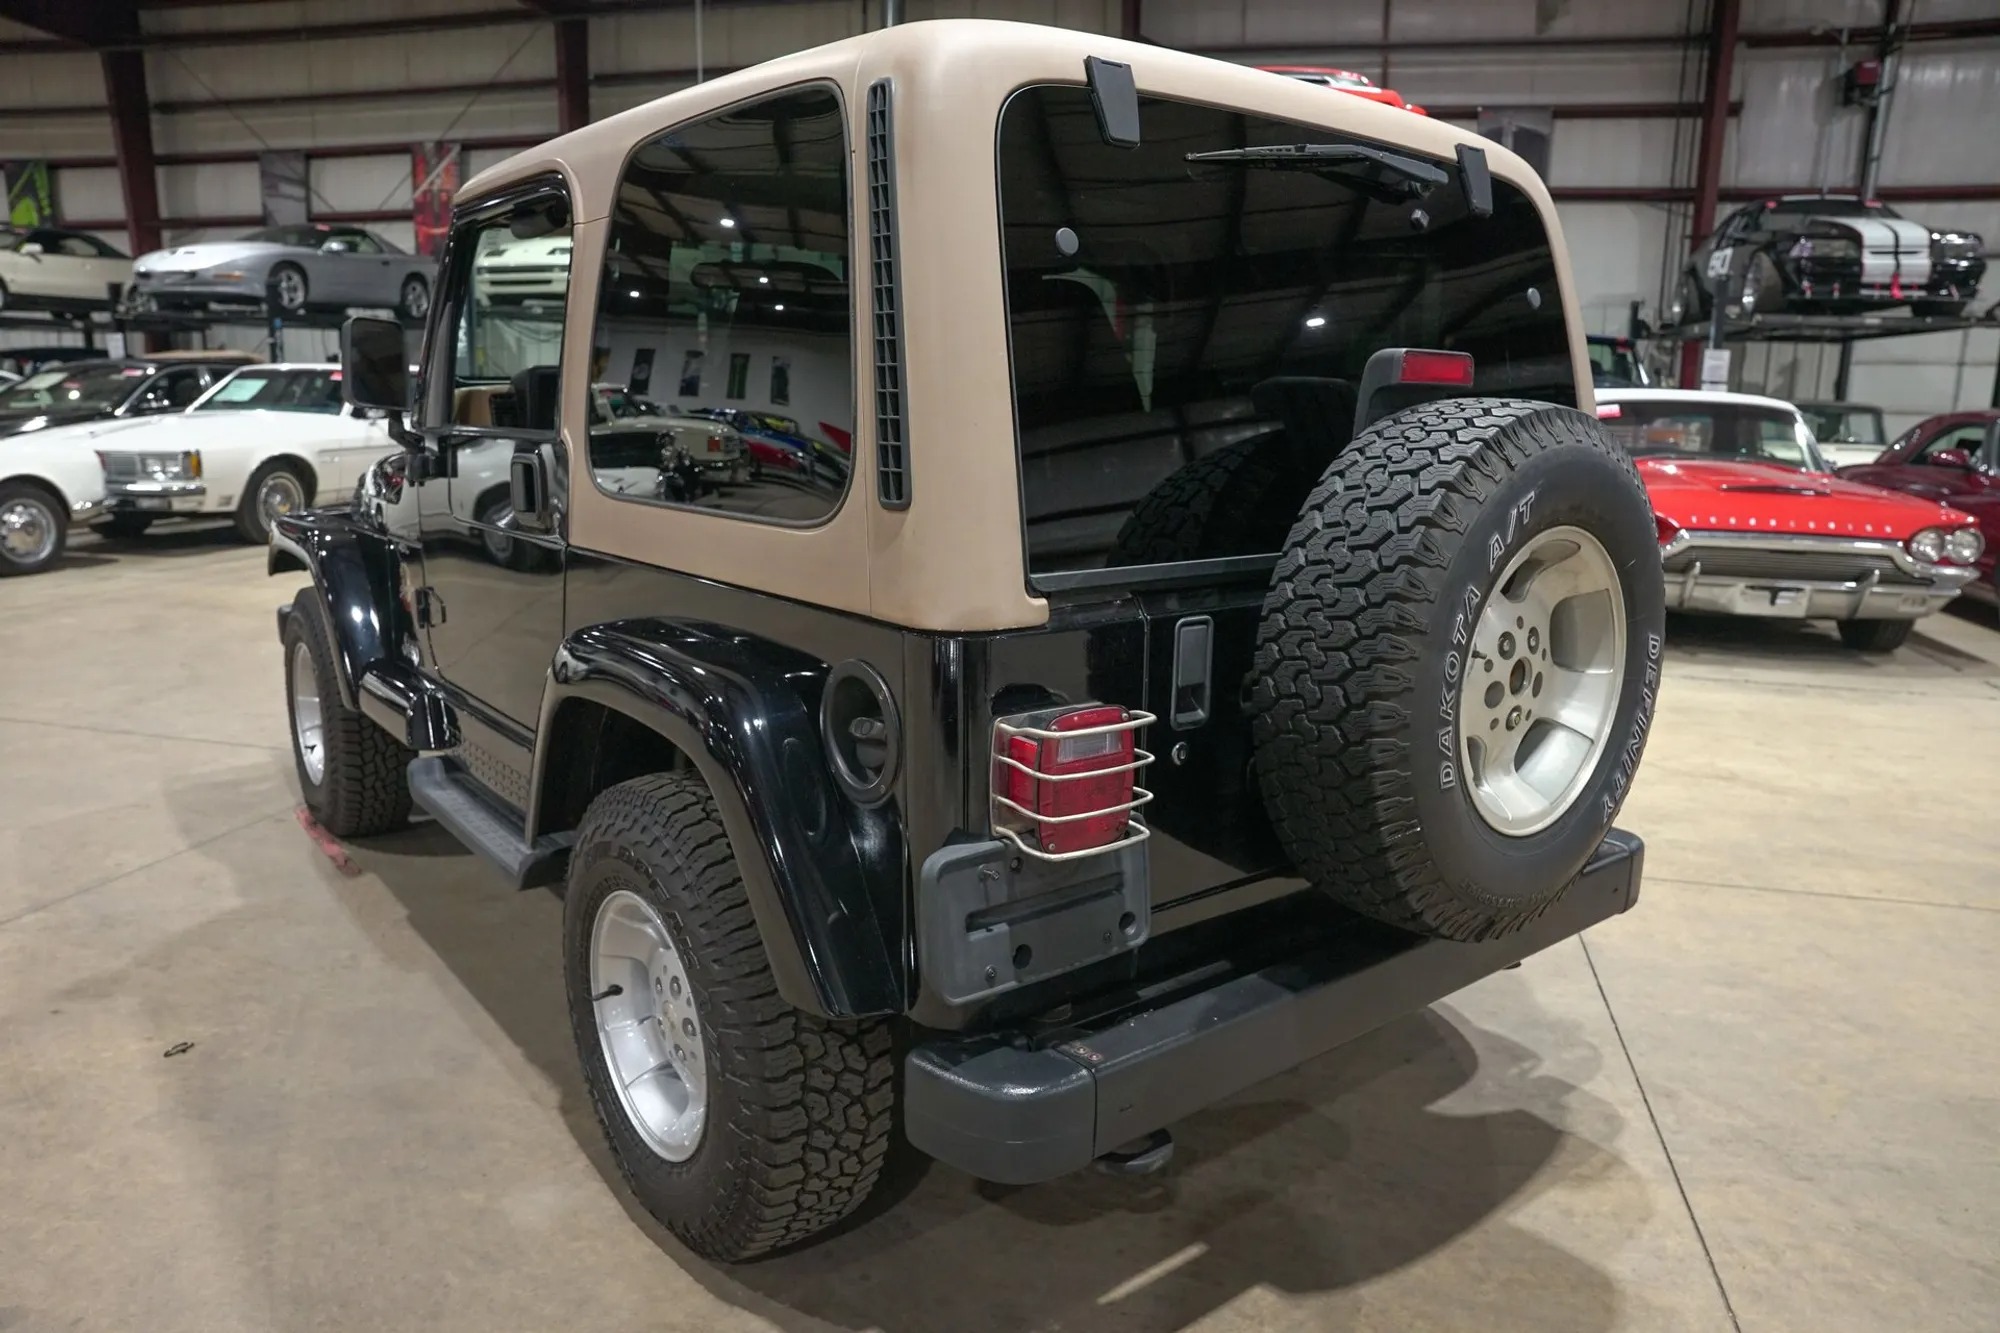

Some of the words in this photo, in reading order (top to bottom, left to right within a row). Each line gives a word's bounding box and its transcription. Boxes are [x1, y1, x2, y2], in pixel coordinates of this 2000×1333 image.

[1438, 585, 1481, 790] DAKOTA
[1488, 491, 1536, 573] A/T
[1603, 634, 1660, 825] DEFINITY
